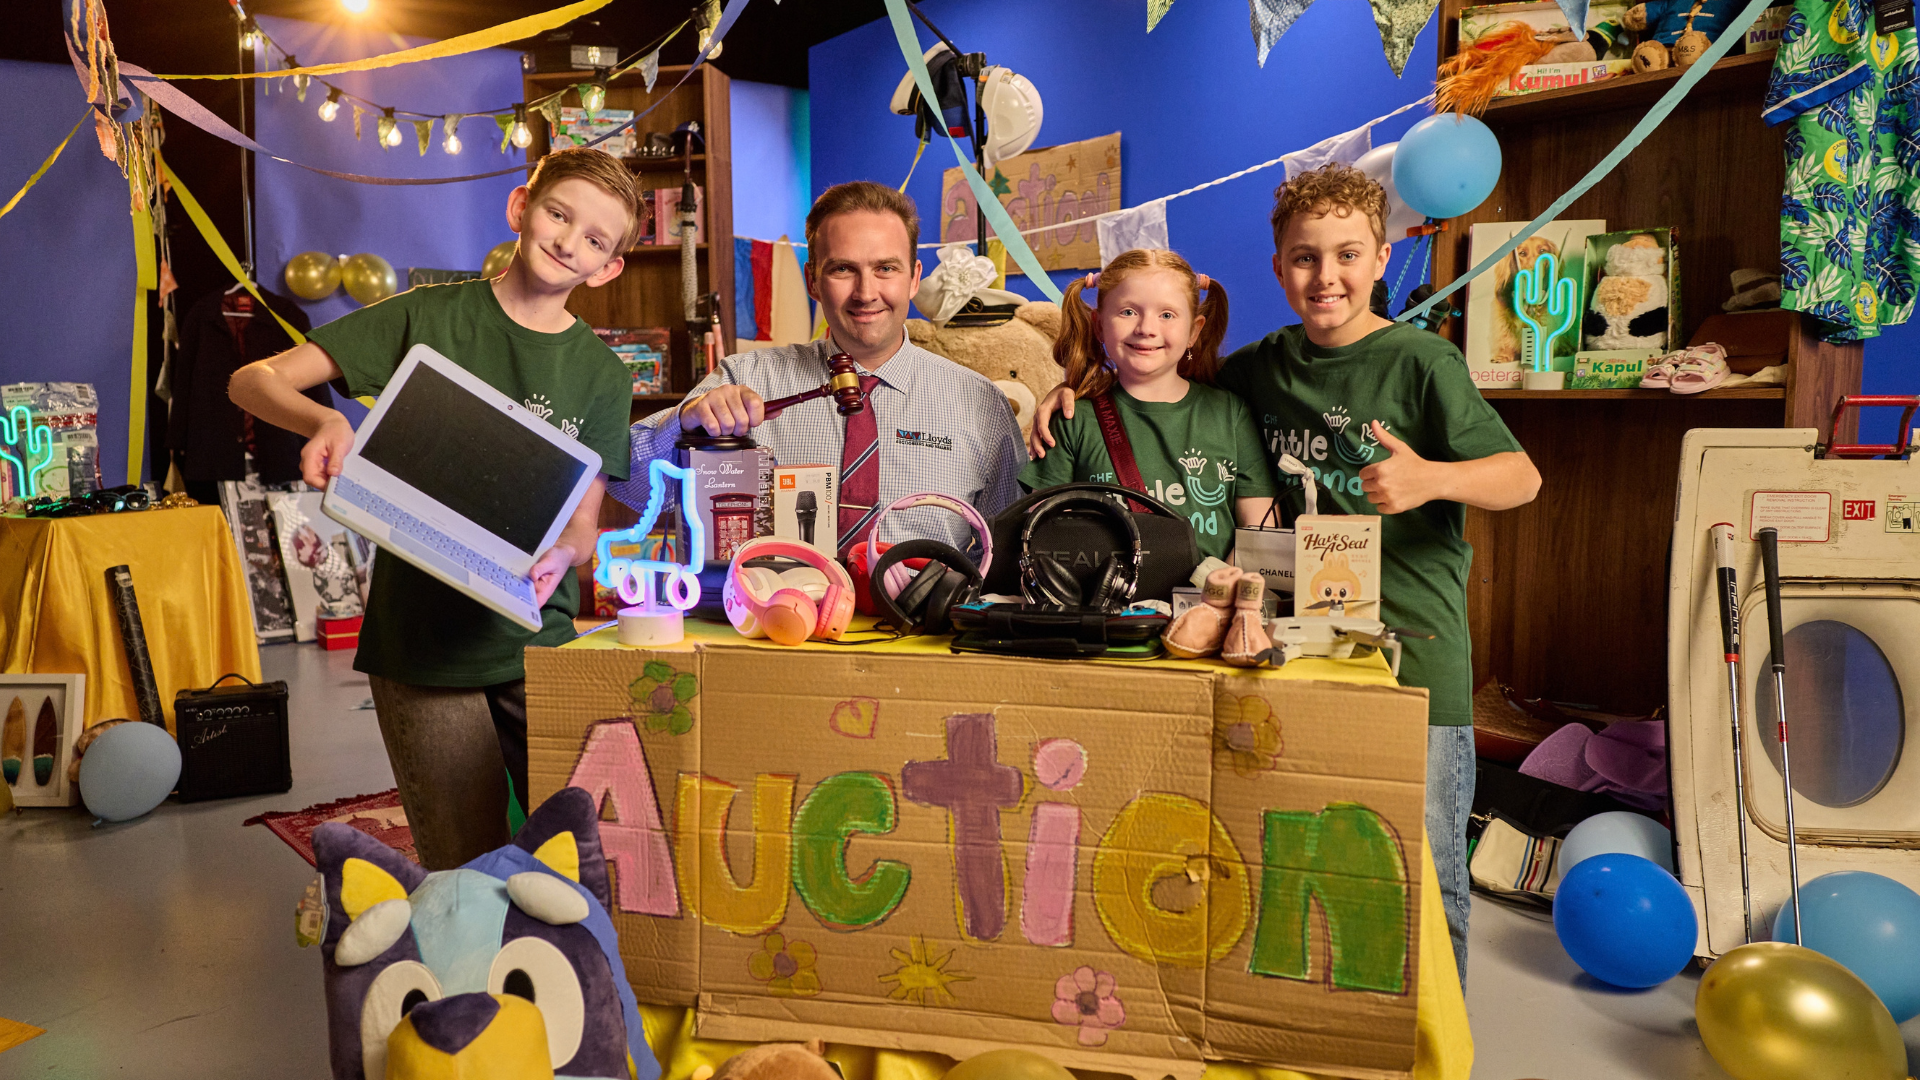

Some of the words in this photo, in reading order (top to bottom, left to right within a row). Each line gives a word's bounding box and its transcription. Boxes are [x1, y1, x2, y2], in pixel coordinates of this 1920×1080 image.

[1679, 45, 1696, 53] M&S
[1509, 68, 1589, 91] Kumul
[945, 163, 1111, 252] action
[1470, 368, 1526, 382] peteral
[1592, 359, 1643, 376] Kapul
[1101, 409, 1123, 446] MAXIE
[922, 432, 952, 445] Lloyds
[695, 463, 717, 475] Snow
[718, 463, 744, 475] Water
[704, 477, 736, 489] Lantern
[782, 477, 794, 486] JBL
[1089, 472, 1113, 483] CHF
[1844, 502, 1873, 518] EXIT
[1303, 533, 1340, 551] Have
[1336, 534, 1369, 551] Seat
[1313, 541, 1336, 561] A
[1259, 568, 1295, 578] CHANEL
[1730, 581, 1740, 646] INFINITE
[566, 712, 1411, 996] Auction
